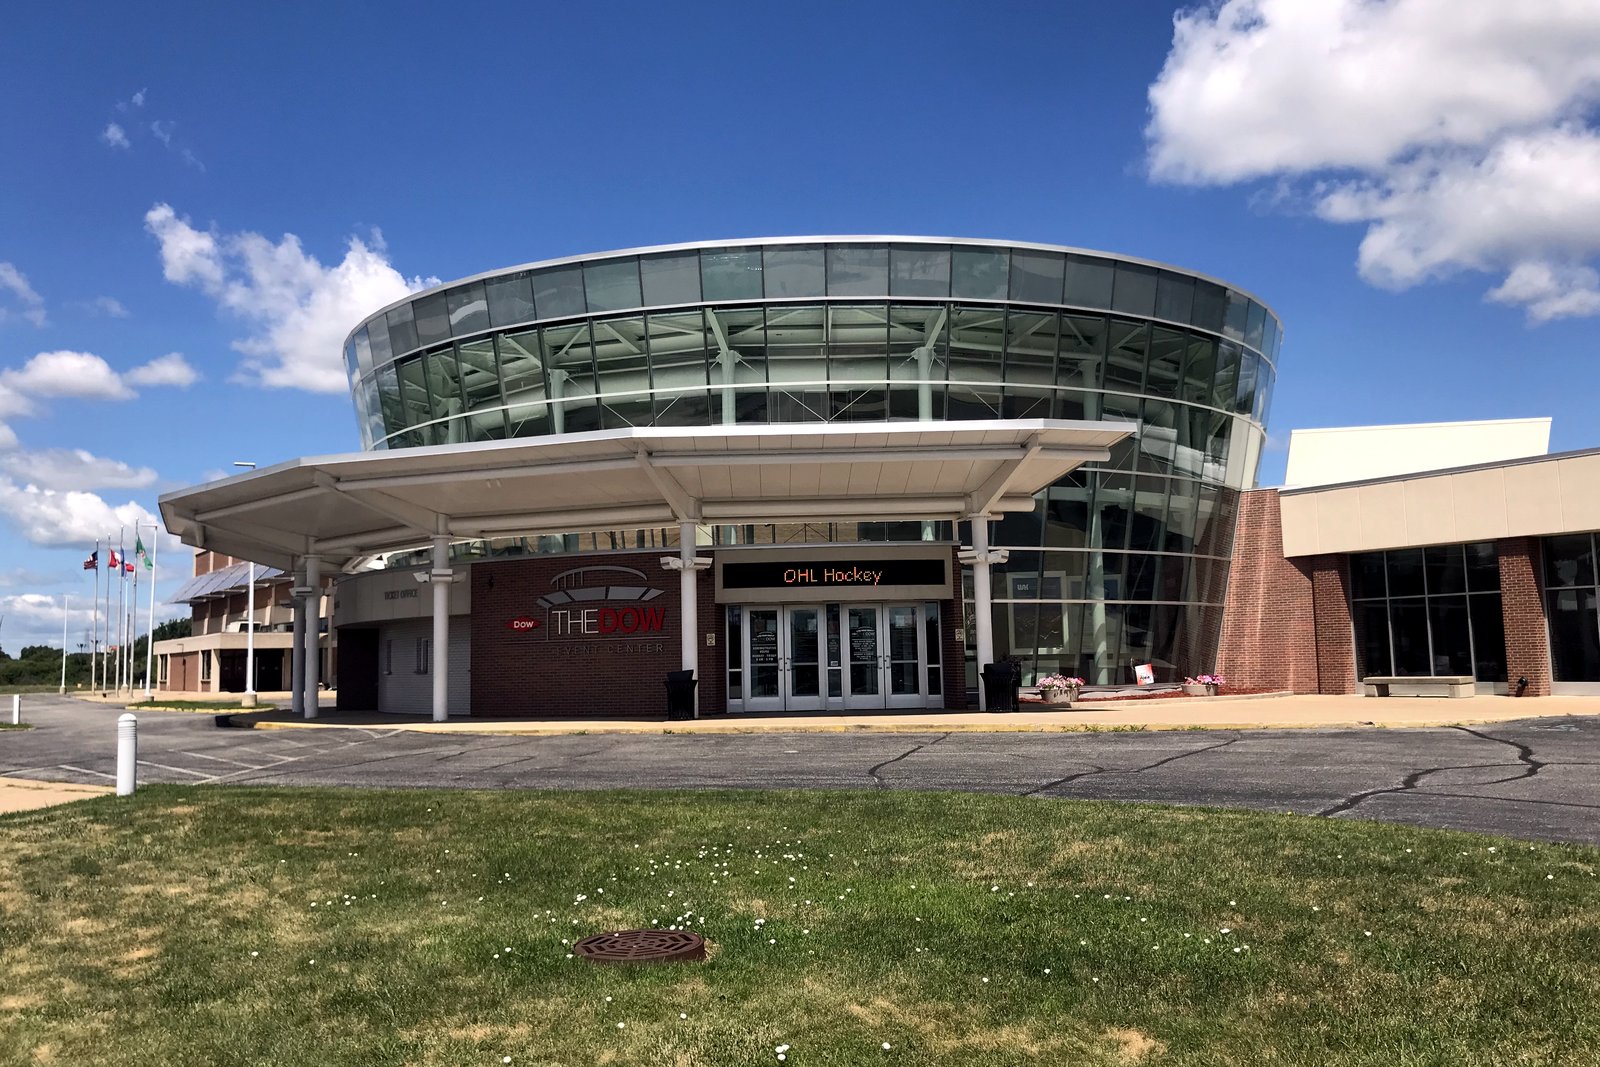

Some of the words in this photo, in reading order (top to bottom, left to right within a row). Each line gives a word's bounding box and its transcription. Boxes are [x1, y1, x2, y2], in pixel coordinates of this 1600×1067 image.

[783, 569, 818, 582] OHL
[824, 567, 883, 586] Hockey
[552, 609, 599, 635] THE
[599, 607, 665, 634] DOW
[606, 643, 664, 654] CENTER
